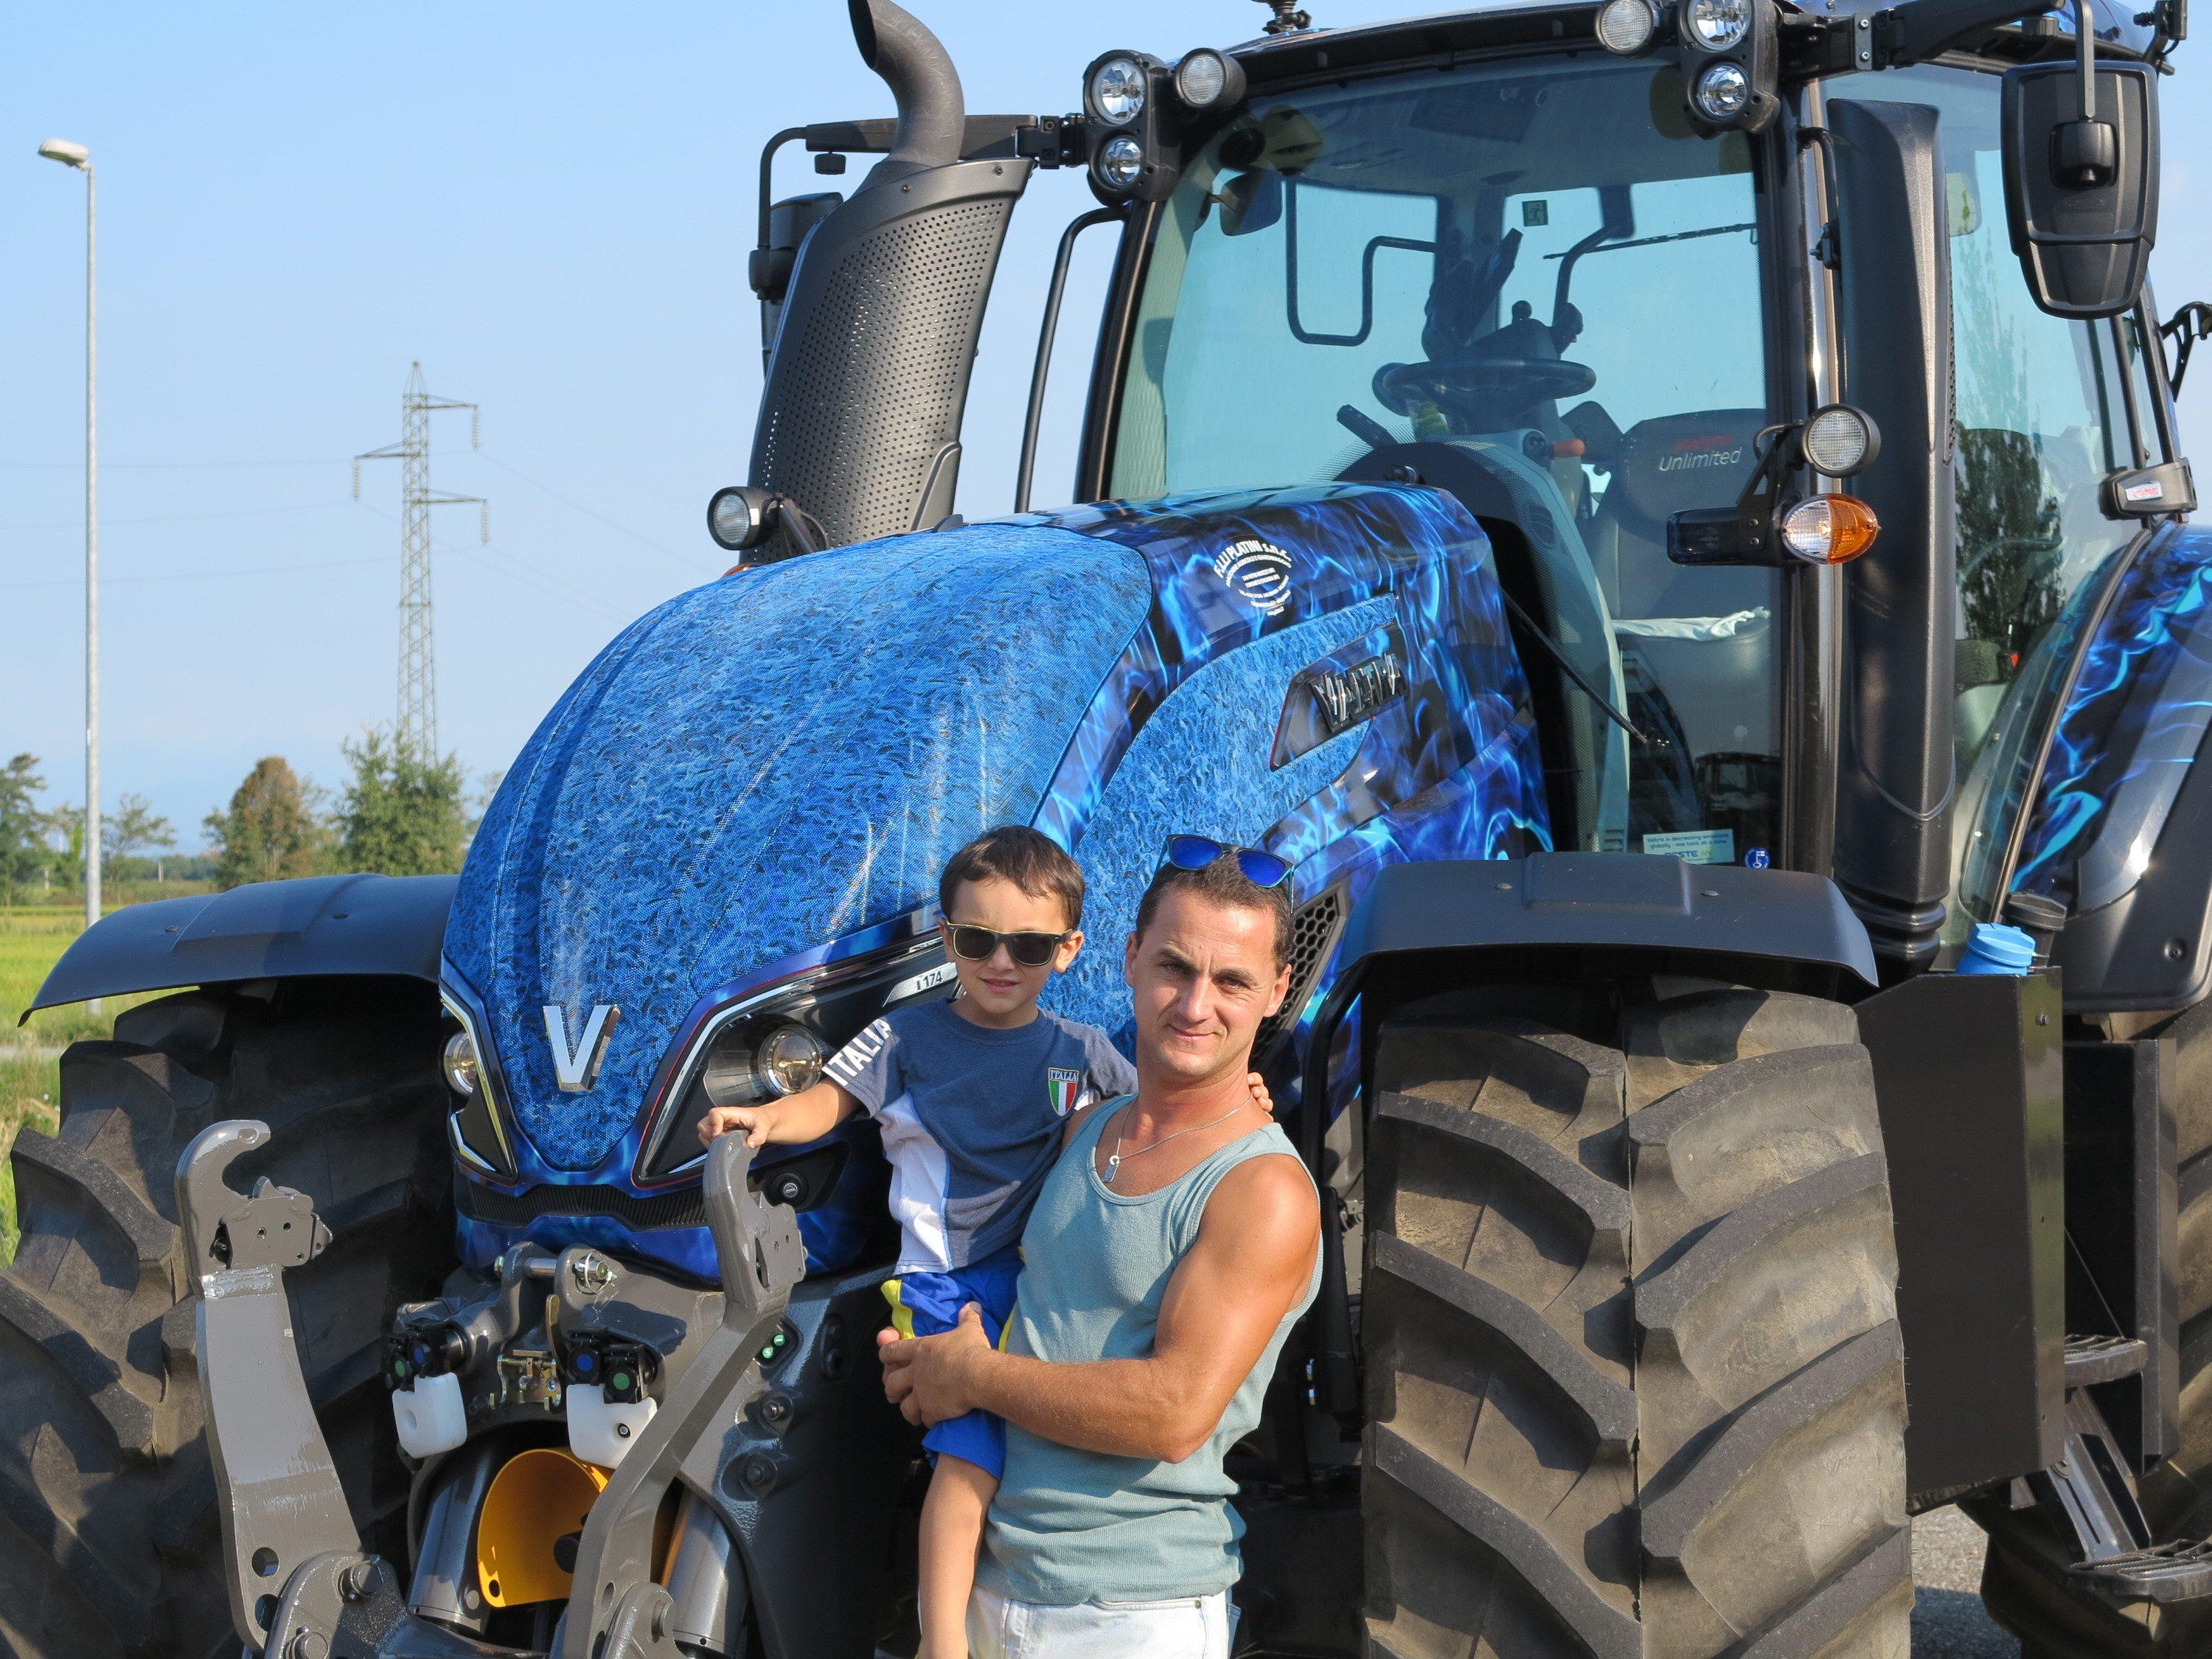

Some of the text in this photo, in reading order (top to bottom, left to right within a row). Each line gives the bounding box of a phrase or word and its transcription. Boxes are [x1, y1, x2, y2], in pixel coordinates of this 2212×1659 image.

[543, 1004, 620, 1092] V
[821, 1018, 892, 1087] ITALIA
[1050, 1069, 1077, 1082] ITALIA
